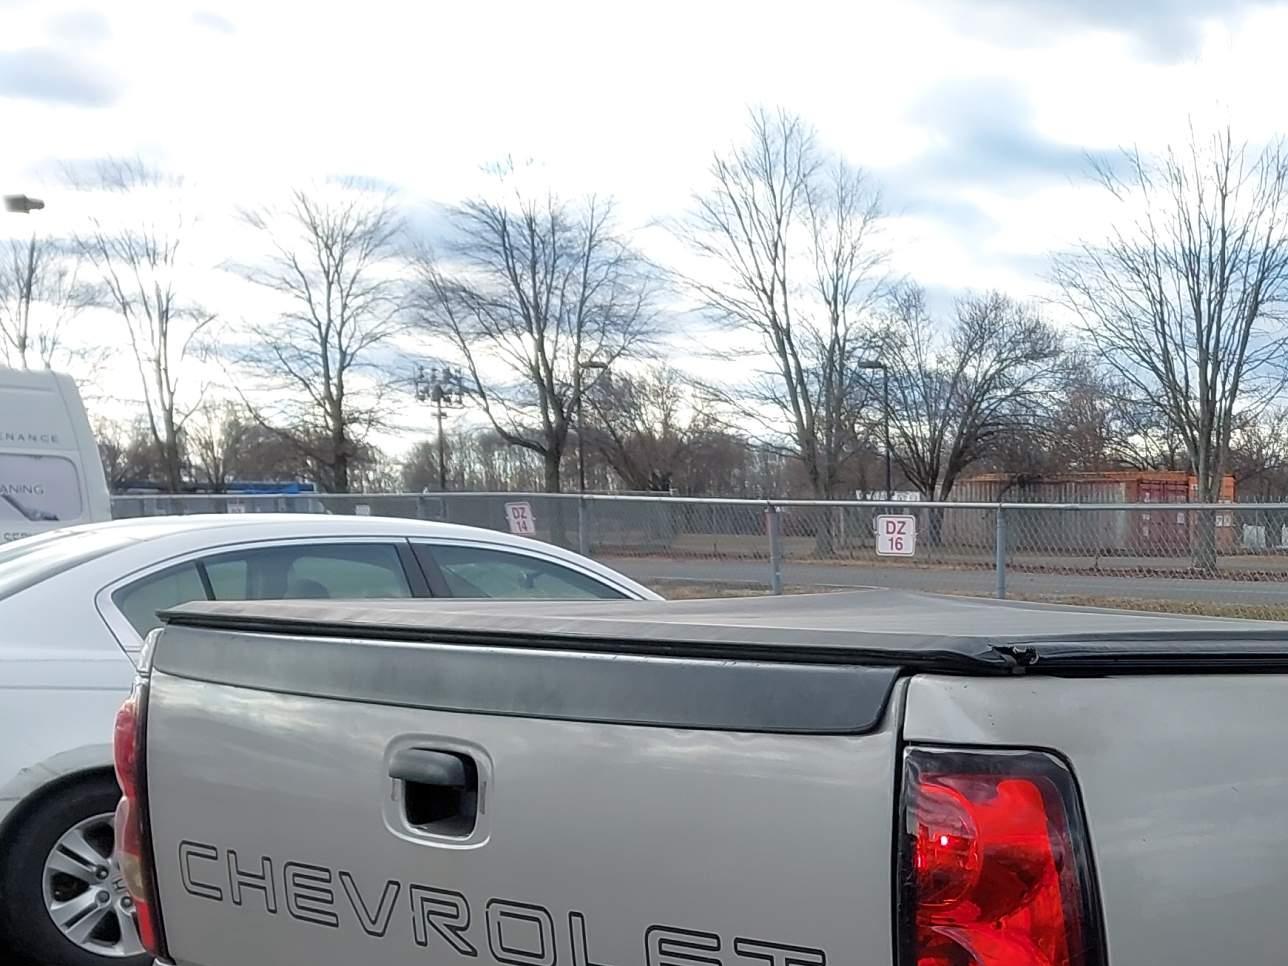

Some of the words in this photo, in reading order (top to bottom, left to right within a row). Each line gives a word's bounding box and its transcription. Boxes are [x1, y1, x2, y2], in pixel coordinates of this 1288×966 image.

[0, 432, 59, 443] NANCE
[511, 506, 528, 519] DZ
[516, 519, 528, 532] 14
[886, 520, 906, 535] DZ
[888, 537, 904, 551] 16
